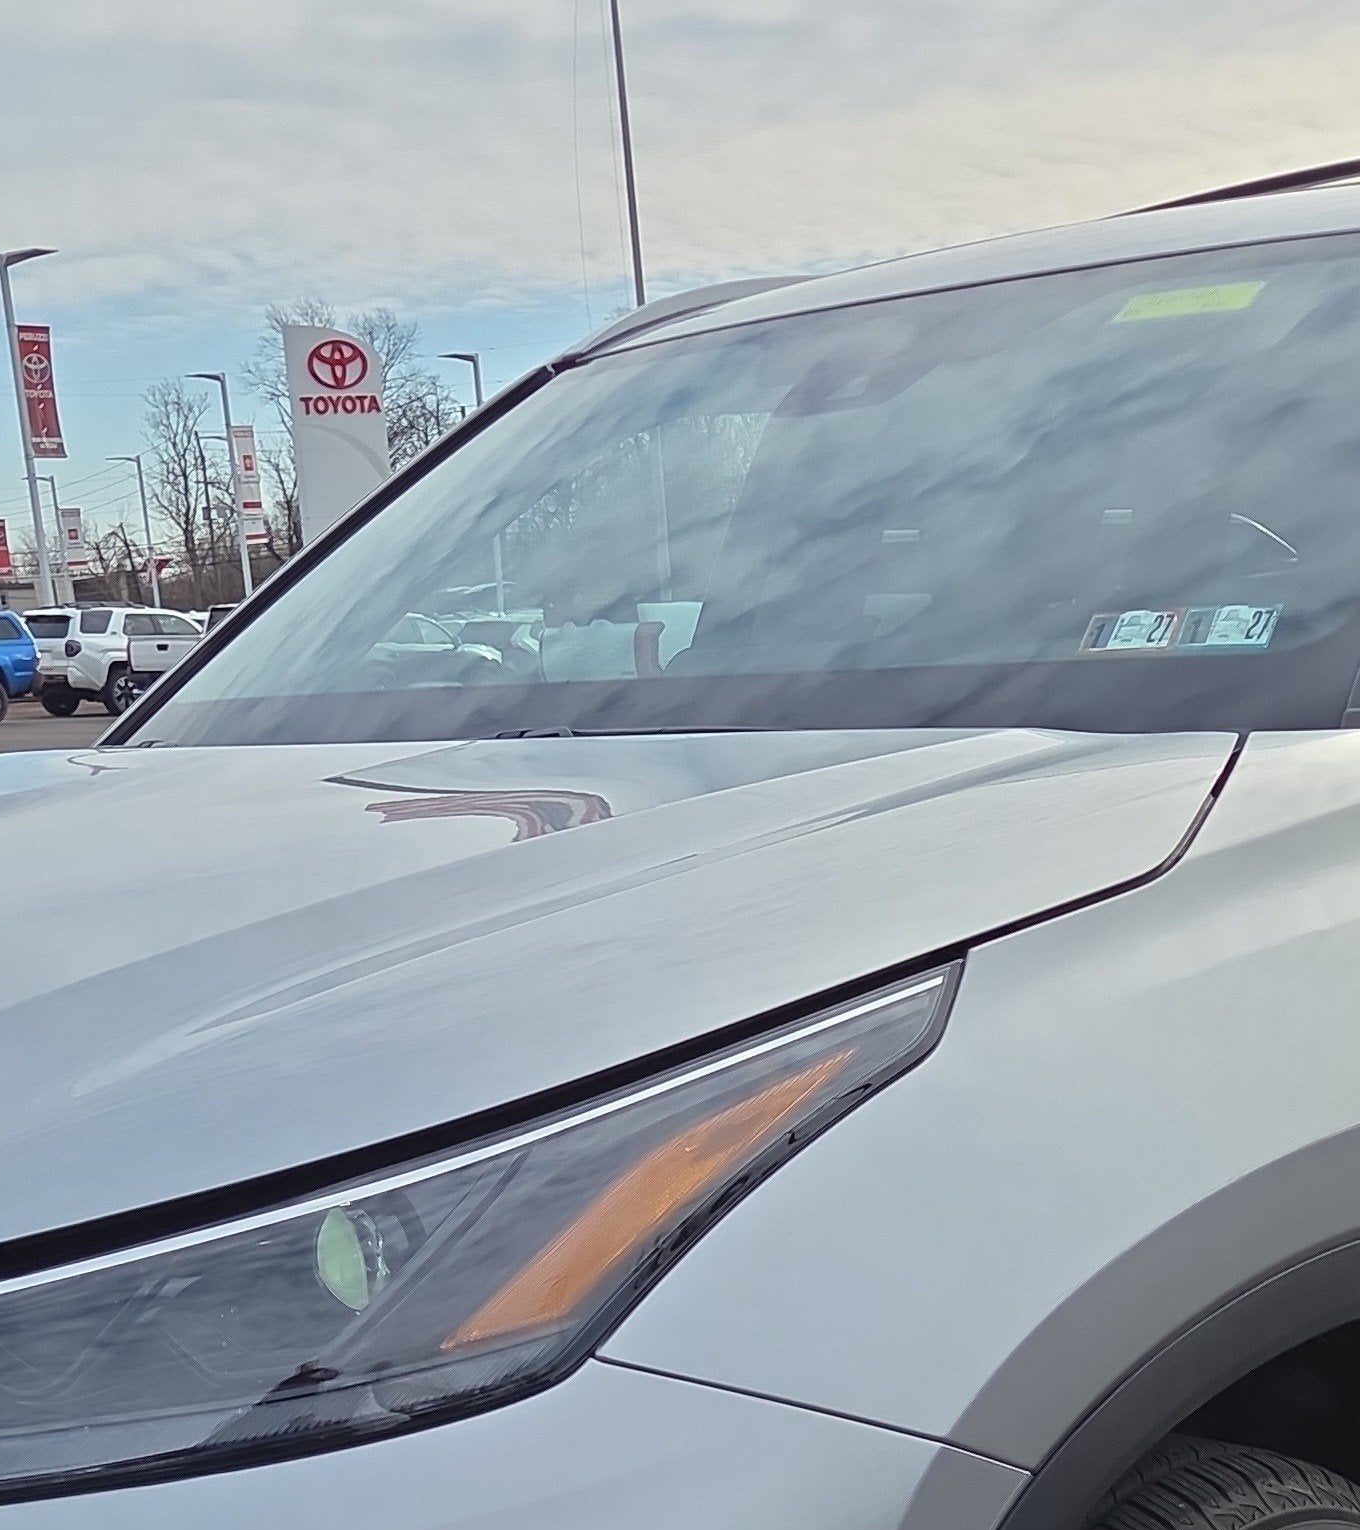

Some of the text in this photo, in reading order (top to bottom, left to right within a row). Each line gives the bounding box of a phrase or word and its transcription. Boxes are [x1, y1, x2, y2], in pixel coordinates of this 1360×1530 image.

[299, 395, 382, 416] TOYOTA
[1145, 613, 1176, 644] 27
[1244, 610, 1276, 642] 27
